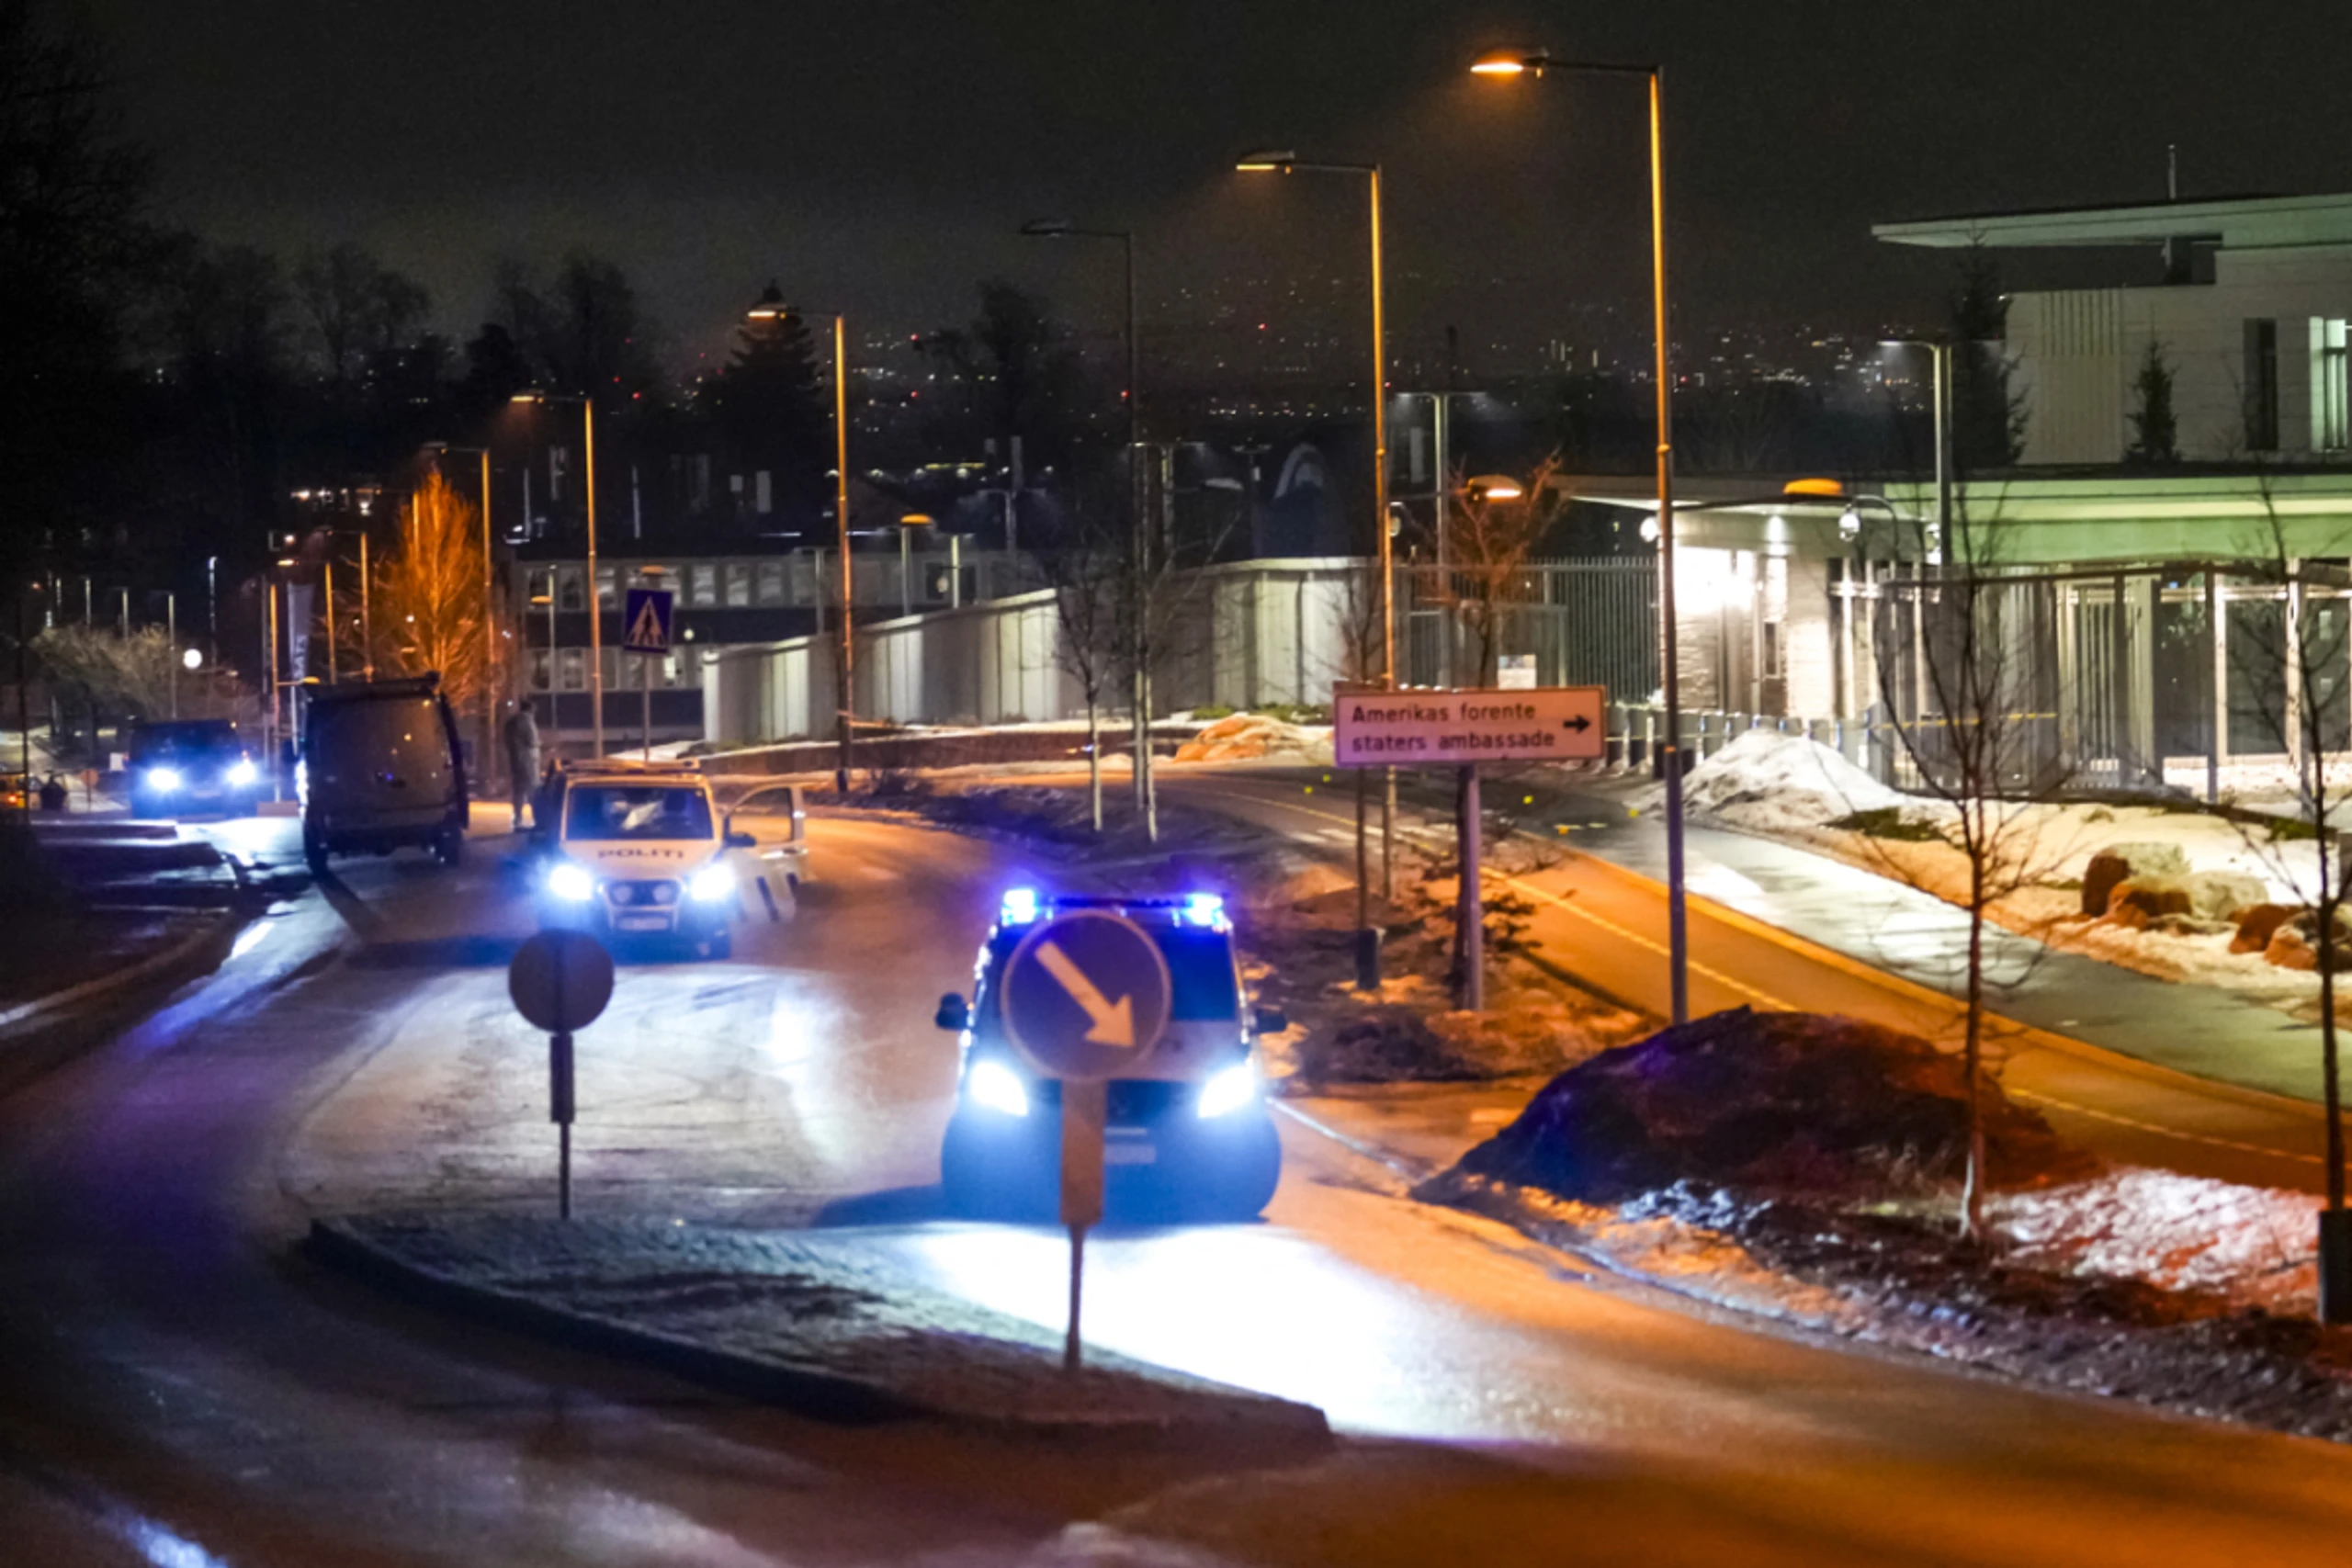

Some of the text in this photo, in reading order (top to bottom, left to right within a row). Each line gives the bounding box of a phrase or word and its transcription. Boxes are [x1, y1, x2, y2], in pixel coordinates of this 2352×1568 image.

[1352, 702, 1535, 722] Amerikas forente
[1352, 730, 1555, 751] staters ambassade
[598, 849, 684, 858] POLITI
